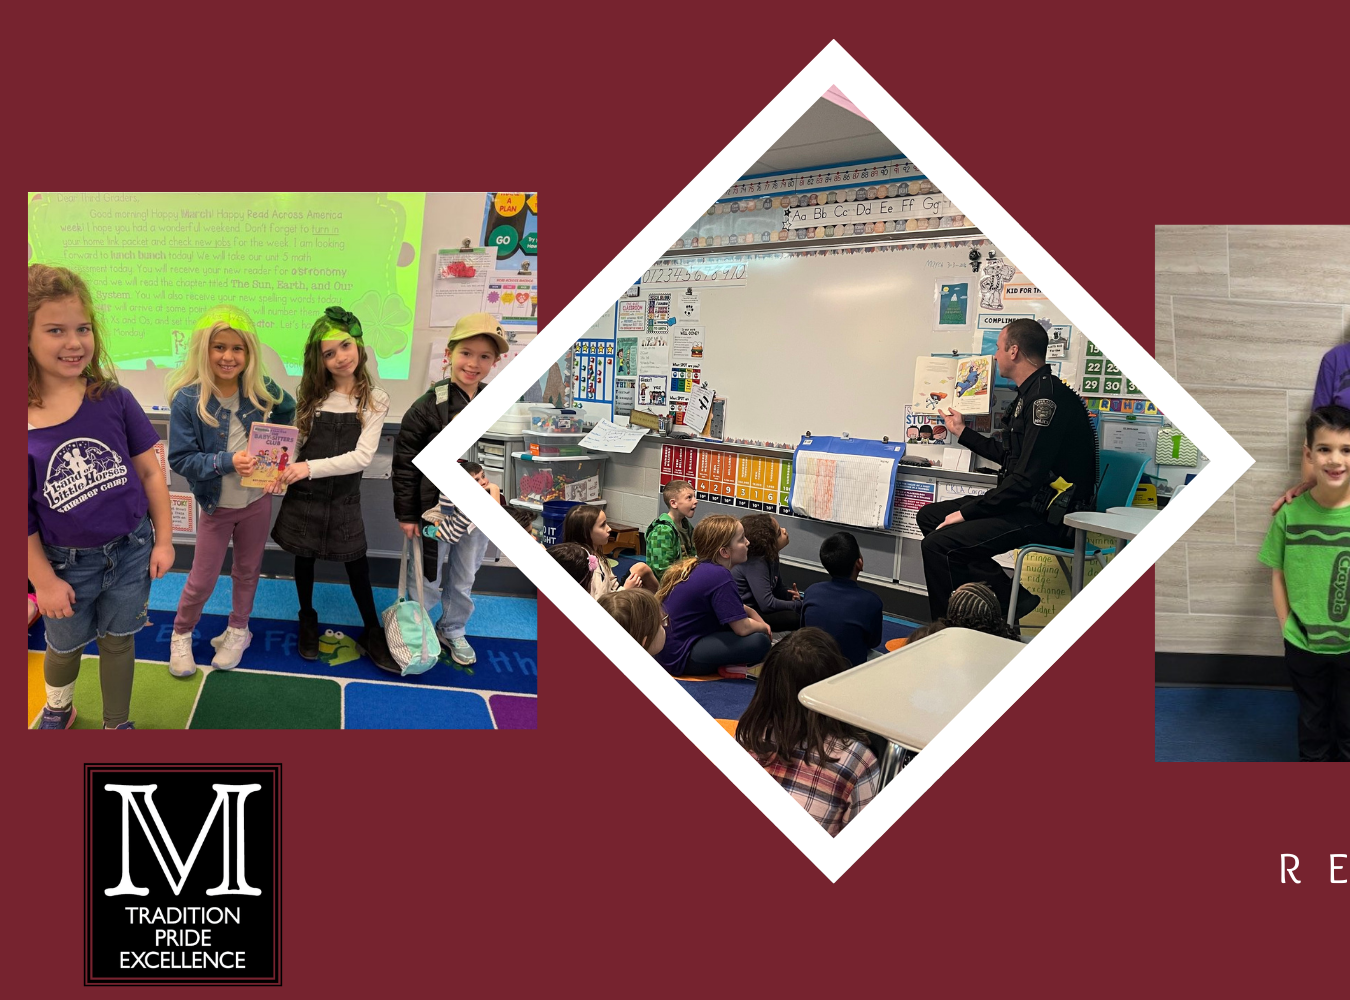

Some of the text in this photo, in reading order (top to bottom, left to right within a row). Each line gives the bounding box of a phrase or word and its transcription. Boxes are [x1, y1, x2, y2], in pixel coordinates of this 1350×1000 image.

[248, 210, 269, 219] Read
[272, 210, 303, 219] Across
[307, 210, 343, 219] America
[793, 197, 940, 221] Aa Bb Cc Dd Ee Ff Gg
[93, 223, 112, 234] hope
[115, 225, 131, 234] you
[132, 223, 148, 232] had
[300, 225, 309, 233] to
[83, 236, 104, 246] home
[107, 236, 119, 245] link
[122, 237, 148, 248] packet
[151, 236, 166, 246] and
[169, 236, 192, 246] check
[233, 237, 248, 247] for
[250, 238, 263, 247] the
[315, 238, 345, 251] looking
[496, 236, 510, 245] GO
[292, 267, 347, 278] astronomy
[231, 279, 249, 288] The
[311, 281, 330, 290] and
[334, 282, 353, 290] Our
[1088, 364, 1120, 372] 22 23
[1084, 381, 1120, 390] 29 30
[1171, 435, 1182, 458] 1
[46, 466, 127, 507] Little Horses
[51, 472, 82, 494] Land
[100, 476, 128, 491] camp
[741, 488, 746, 496] 3
[755, 490, 758, 498] 1
[768, 493, 773, 501] 6
[1026, 565, 1059, 578] nudging
[1027, 576, 1051, 586] ridge
[1034, 604, 1056, 617] udget
